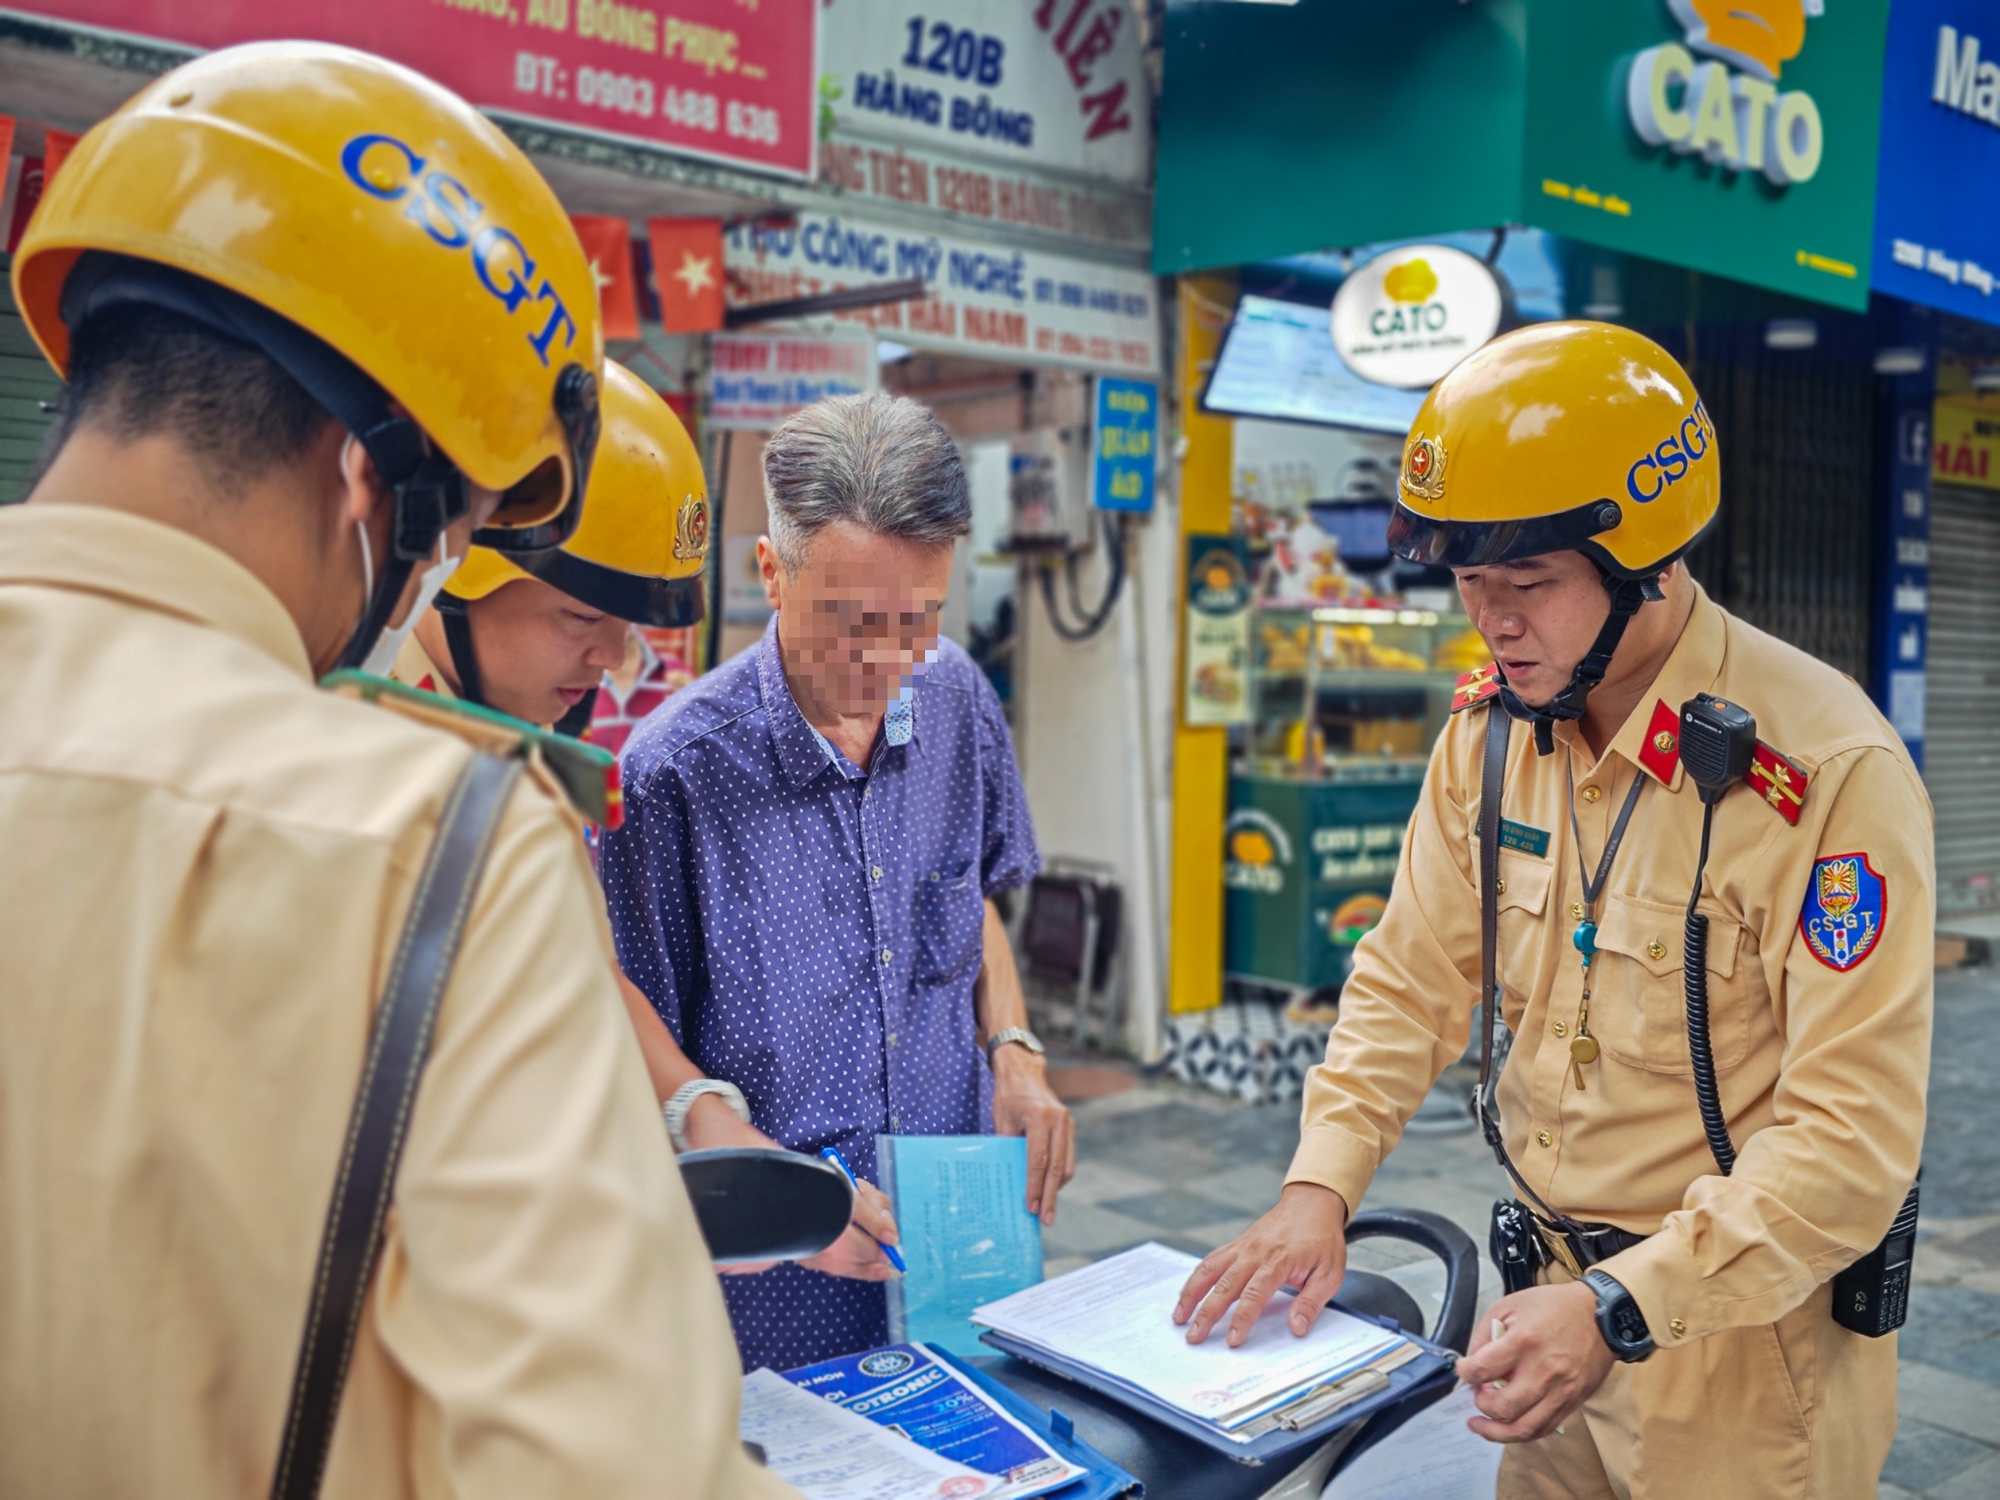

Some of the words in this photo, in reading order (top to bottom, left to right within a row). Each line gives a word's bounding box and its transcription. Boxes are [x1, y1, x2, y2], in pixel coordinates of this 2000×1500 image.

[902, 14, 1005, 88] 120B
[576, 65, 655, 118] 0903
[853, 67, 943, 126] HÀNG
[949, 92, 1034, 148] BÔNG
[1629, 41, 1823, 185] CATO
[340, 133, 578, 370] CSGT
[801, 215, 889, 276] CÔNG
[962, 304, 1027, 348] NAM
[1369, 301, 1448, 337] CATO
[1808, 910, 1875, 934] CSGT
